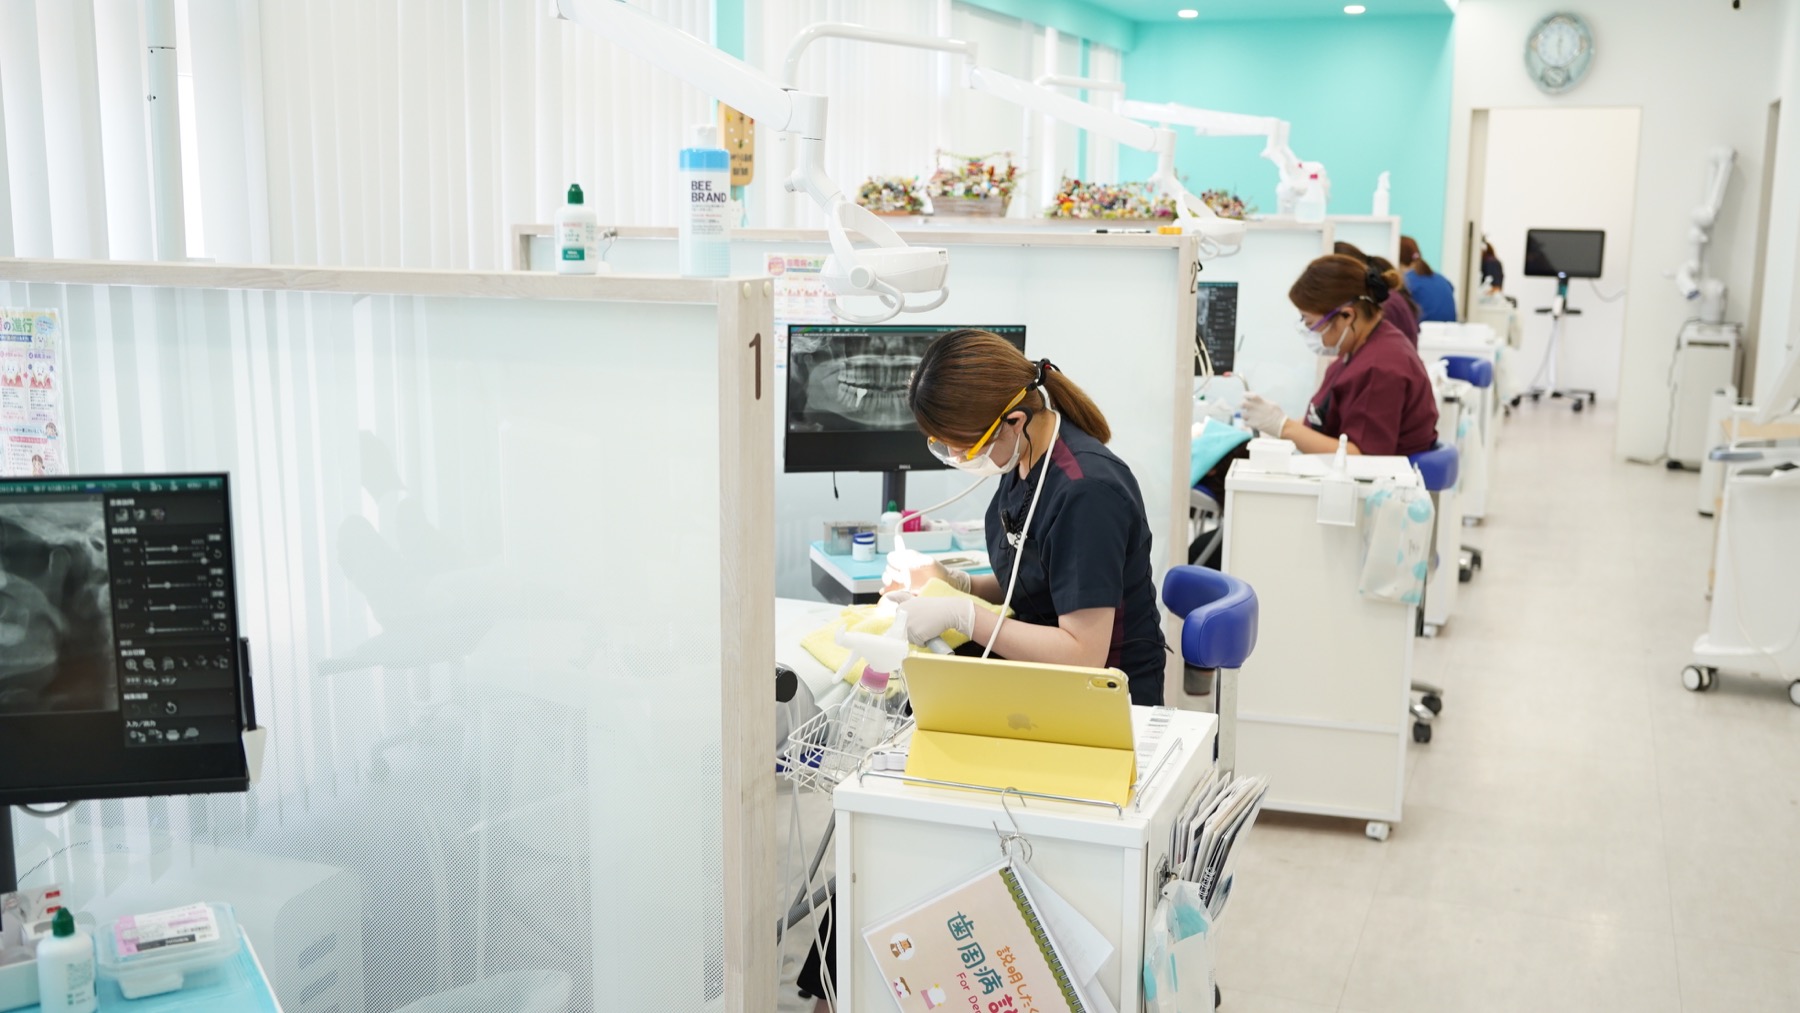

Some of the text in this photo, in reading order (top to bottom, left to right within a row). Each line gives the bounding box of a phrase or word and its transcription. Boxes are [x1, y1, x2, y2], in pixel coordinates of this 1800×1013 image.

[691, 180, 712, 191] BEE
[691, 192, 727, 203] BRAND
[1190, 261, 1197, 294] 2
[0, 316, 32, 333] の進行
[749, 332, 761, 400] 1
[956, 972, 970, 991] For
